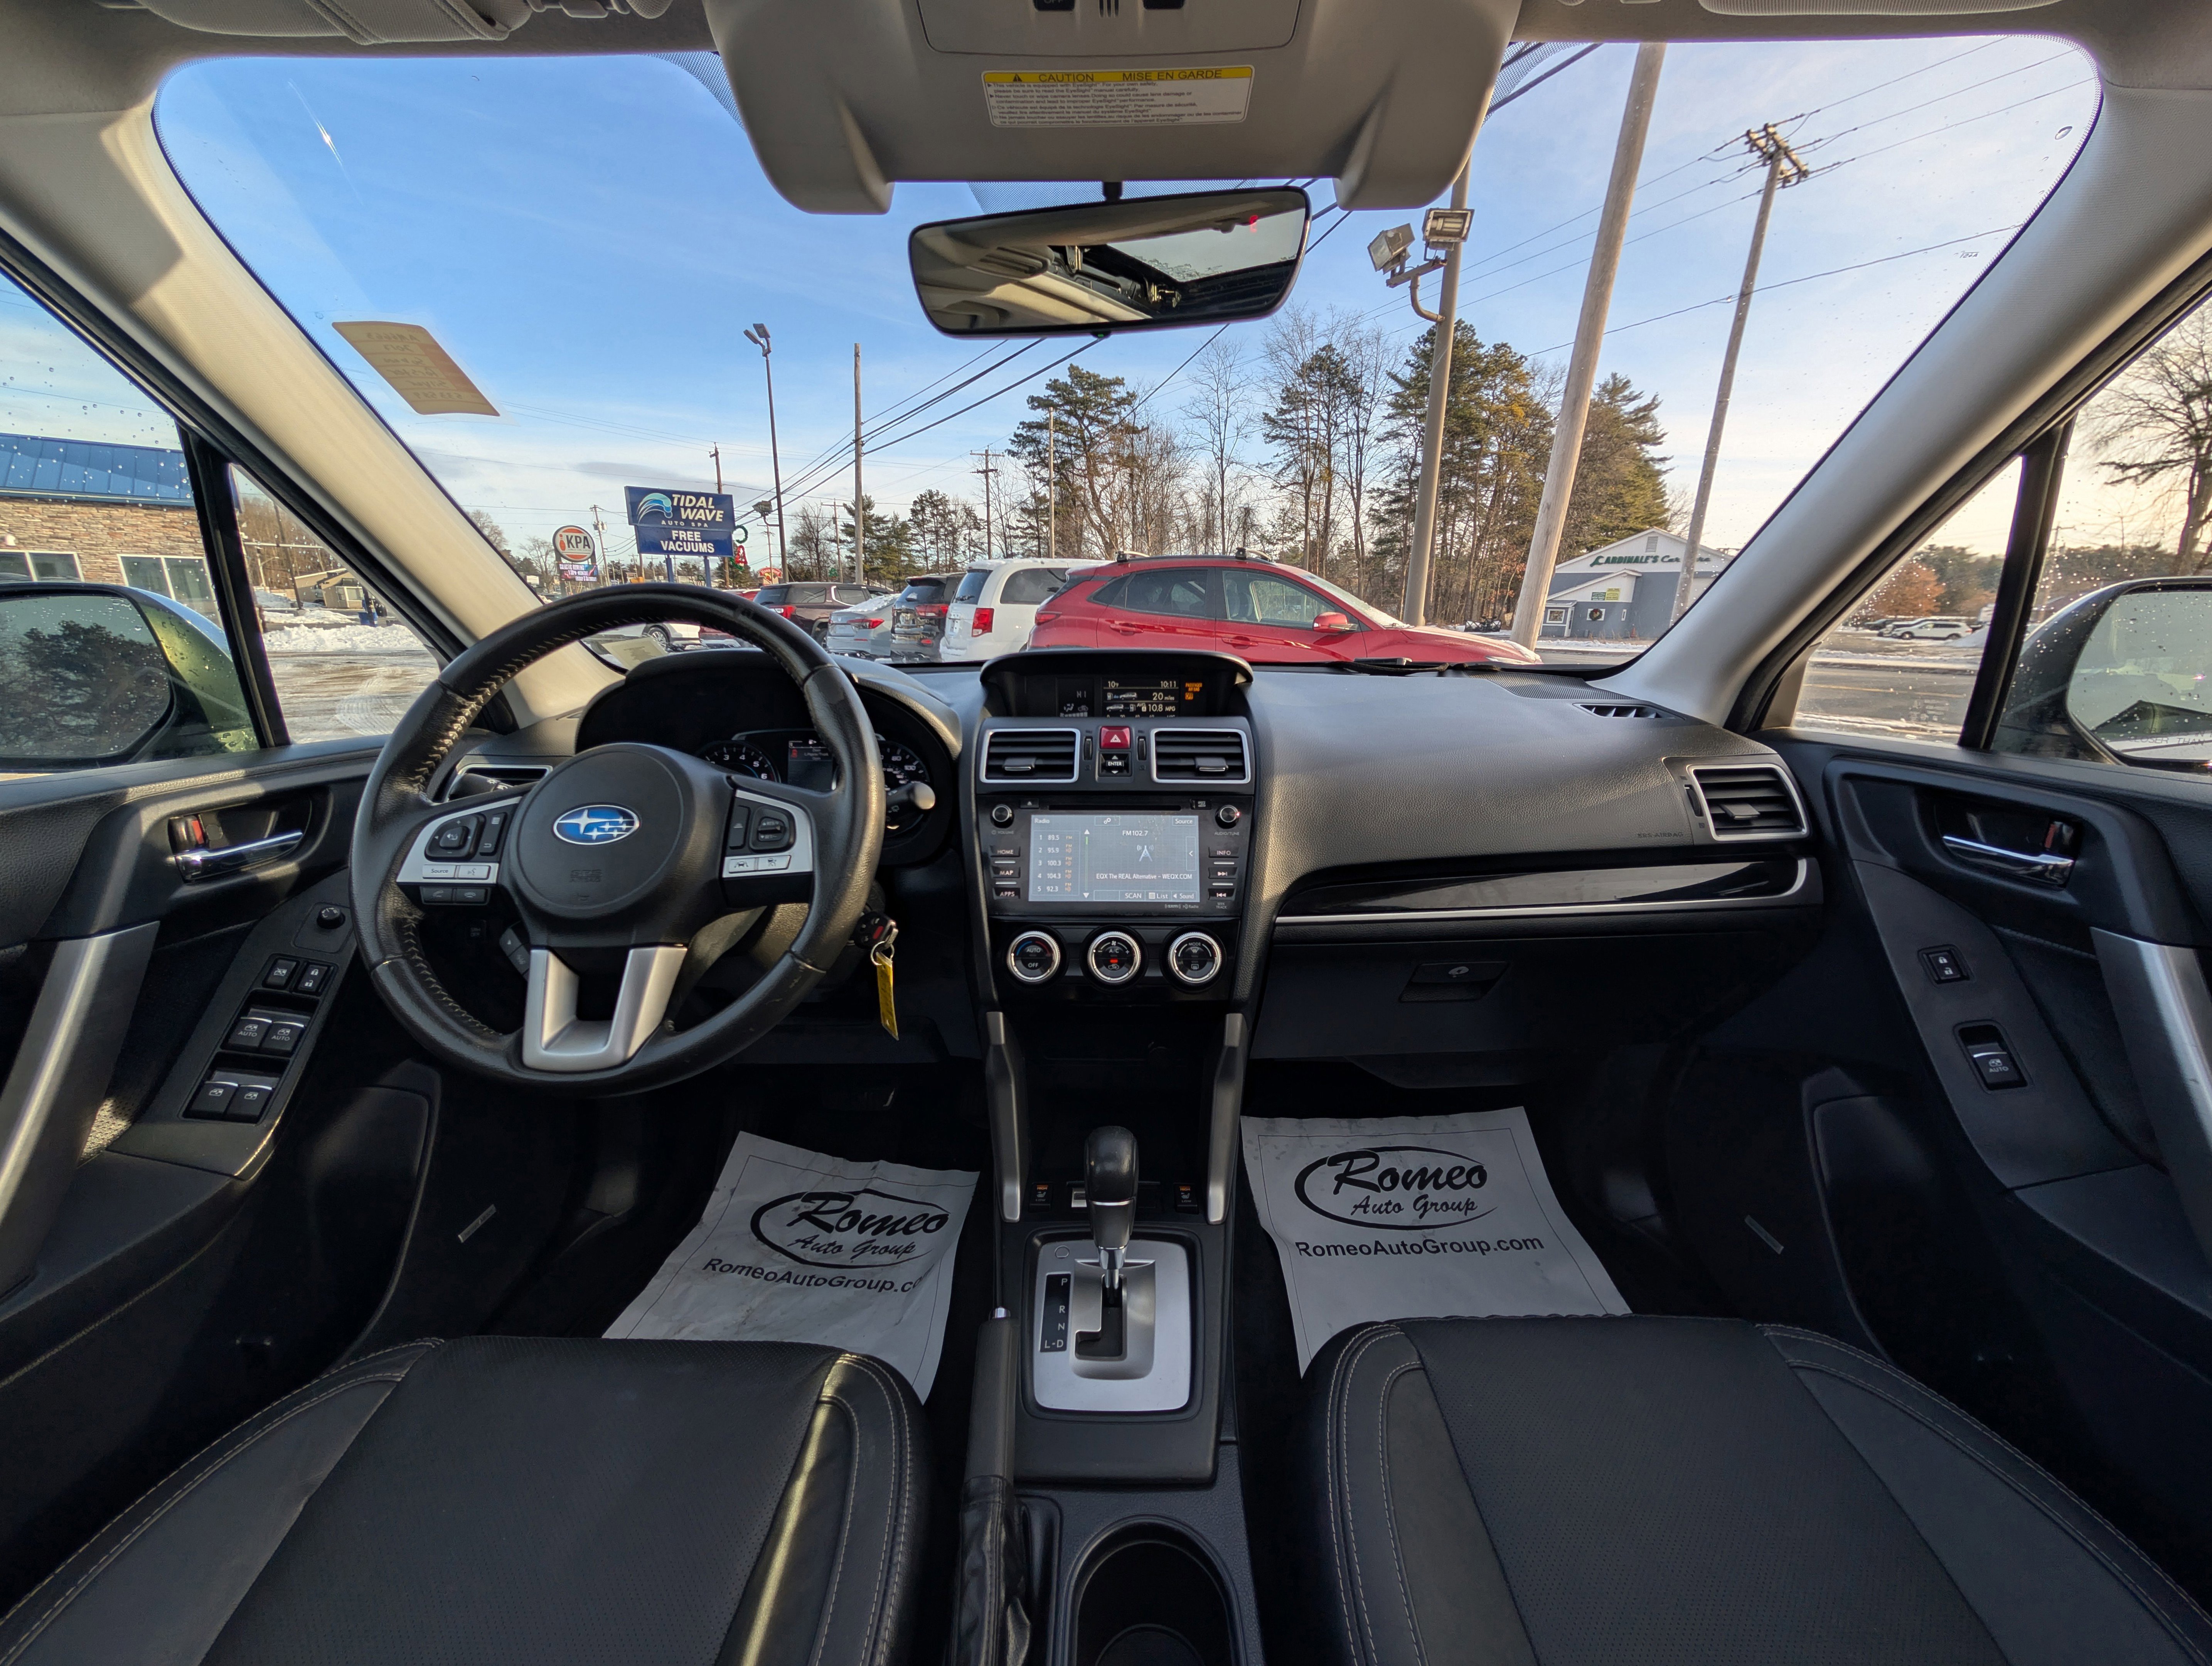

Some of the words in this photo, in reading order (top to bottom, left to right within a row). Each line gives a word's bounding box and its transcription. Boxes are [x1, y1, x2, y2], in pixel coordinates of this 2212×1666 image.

[1039, 74, 1094, 82] CAUTION
[1122, 72, 1152, 81] MISE
[1157, 71, 1174, 80] EN
[1178, 69, 1223, 79] GARDE
[672, 494, 714, 508] TIDAL
[681, 508, 724, 521] WAVE
[566, 535, 591, 549] KPA
[672, 530, 701, 541] FREE
[660, 541, 714, 553] VACUUMS
[1589, 555, 1659, 567] CARDINALE'S
[1152, 692, 1163, 700] 20
[1326, 1150, 1488, 1195] Romeo
[1350, 1195, 1404, 1215] Auto
[1412, 1194, 1478, 1219] Group
[786, 1192, 950, 1236] Romeo
[787, 1234, 844, 1255] Auto
[849, 1239, 916, 1260] Group
[1295, 1237, 1545, 1257] RomeoAutoGroup.com
[1059, 1305, 1065, 1313] R
